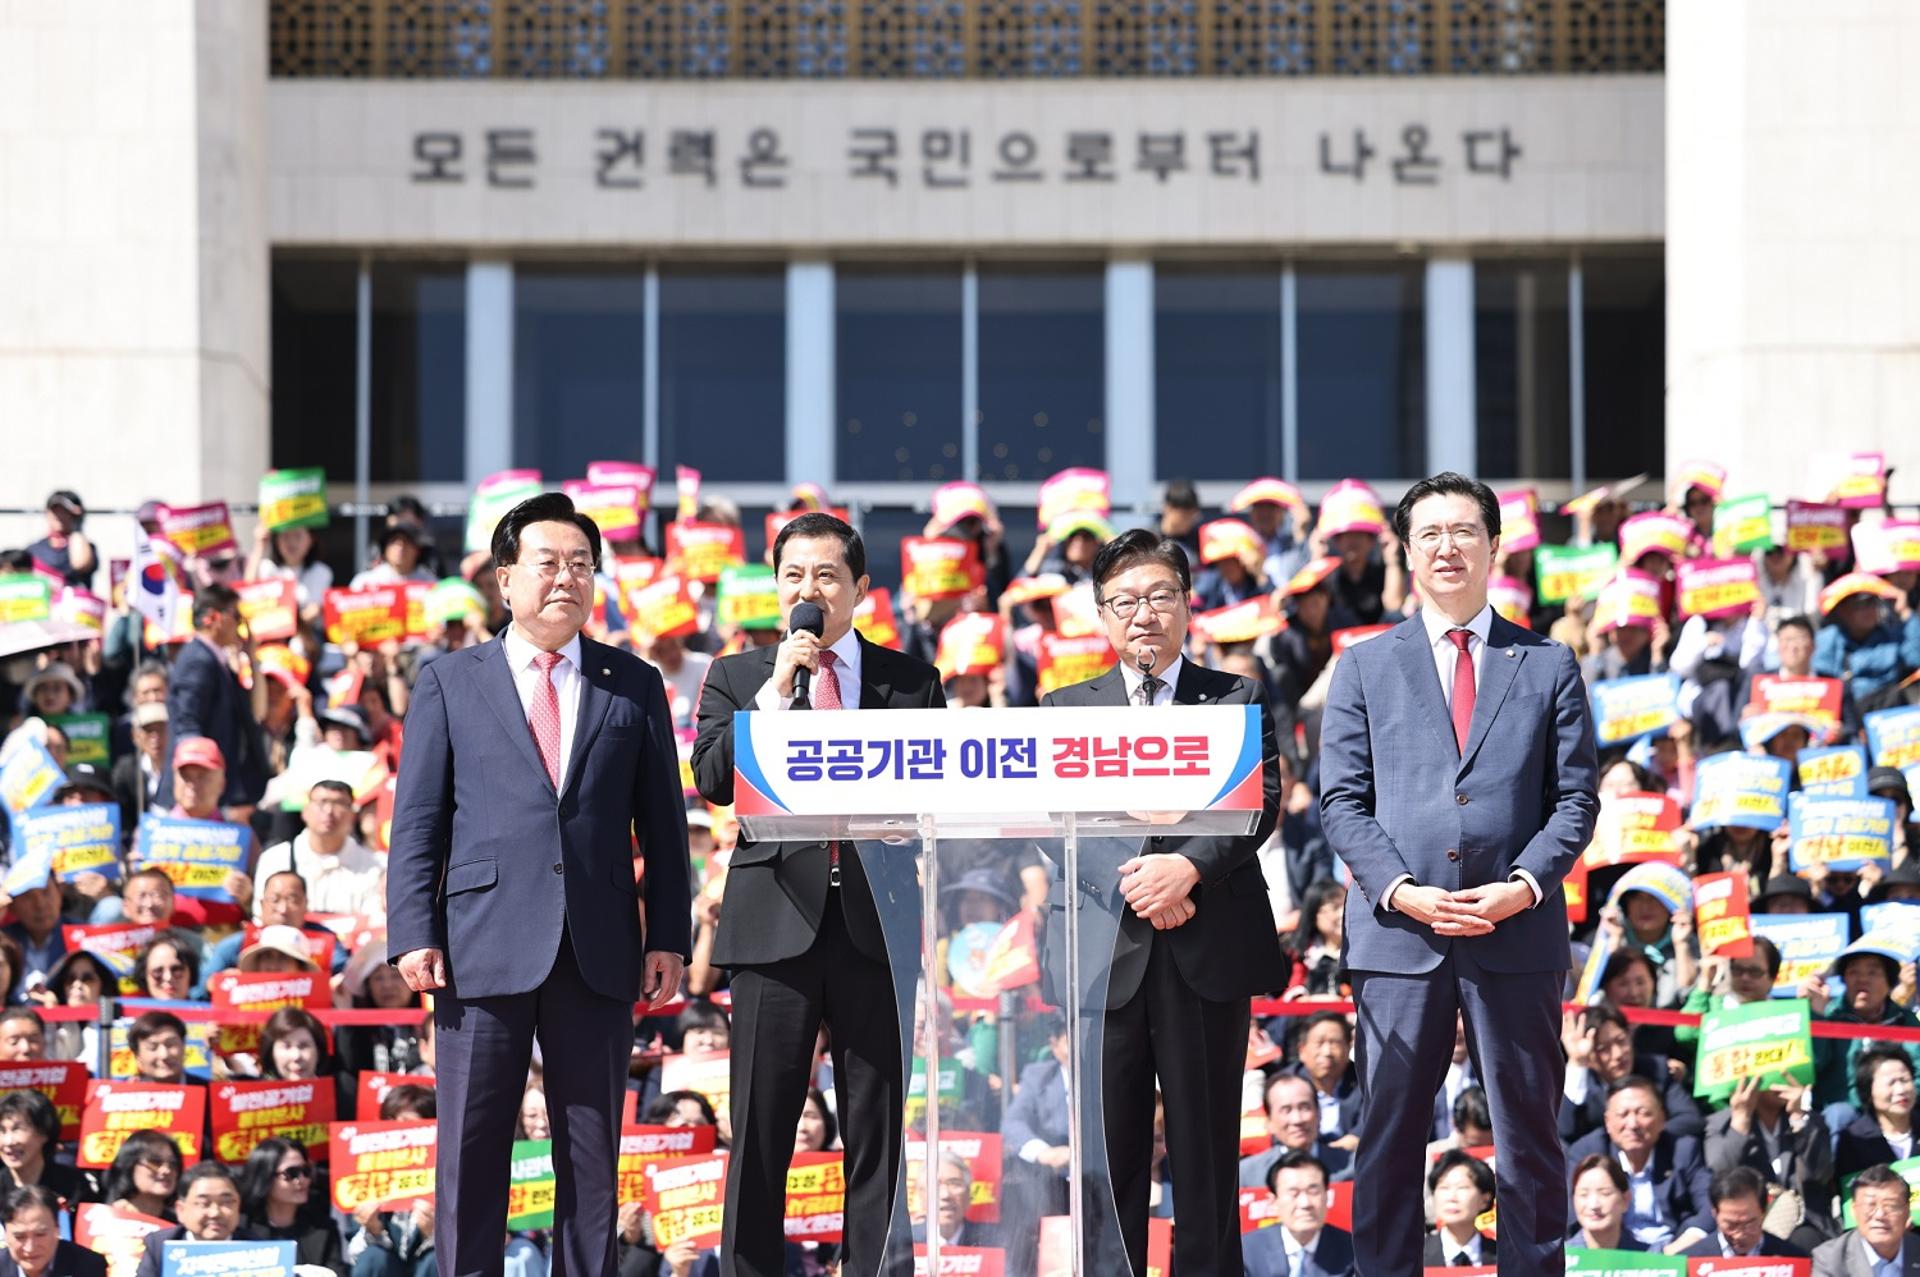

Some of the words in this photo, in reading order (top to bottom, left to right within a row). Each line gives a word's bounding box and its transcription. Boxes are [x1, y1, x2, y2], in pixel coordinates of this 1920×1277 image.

[411, 128, 536, 189] 모든
[594, 126, 789, 189] 권력은
[848, 127, 1261, 189] 국민으로부터
[1319, 124, 1523, 186] 나온다
[786, 738, 947, 781] 공공기관
[960, 737, 1038, 780] 이전
[1052, 735, 1211, 779] 경남으로
[1713, 1047, 1751, 1079] 통합
[1755, 1039, 1793, 1067] 반대!
[229, 1084, 314, 1112] 발전공기업
[238, 1104, 305, 1129] 통합본사
[348, 1171, 390, 1202] 경남
[660, 1212, 689, 1240] 경남
